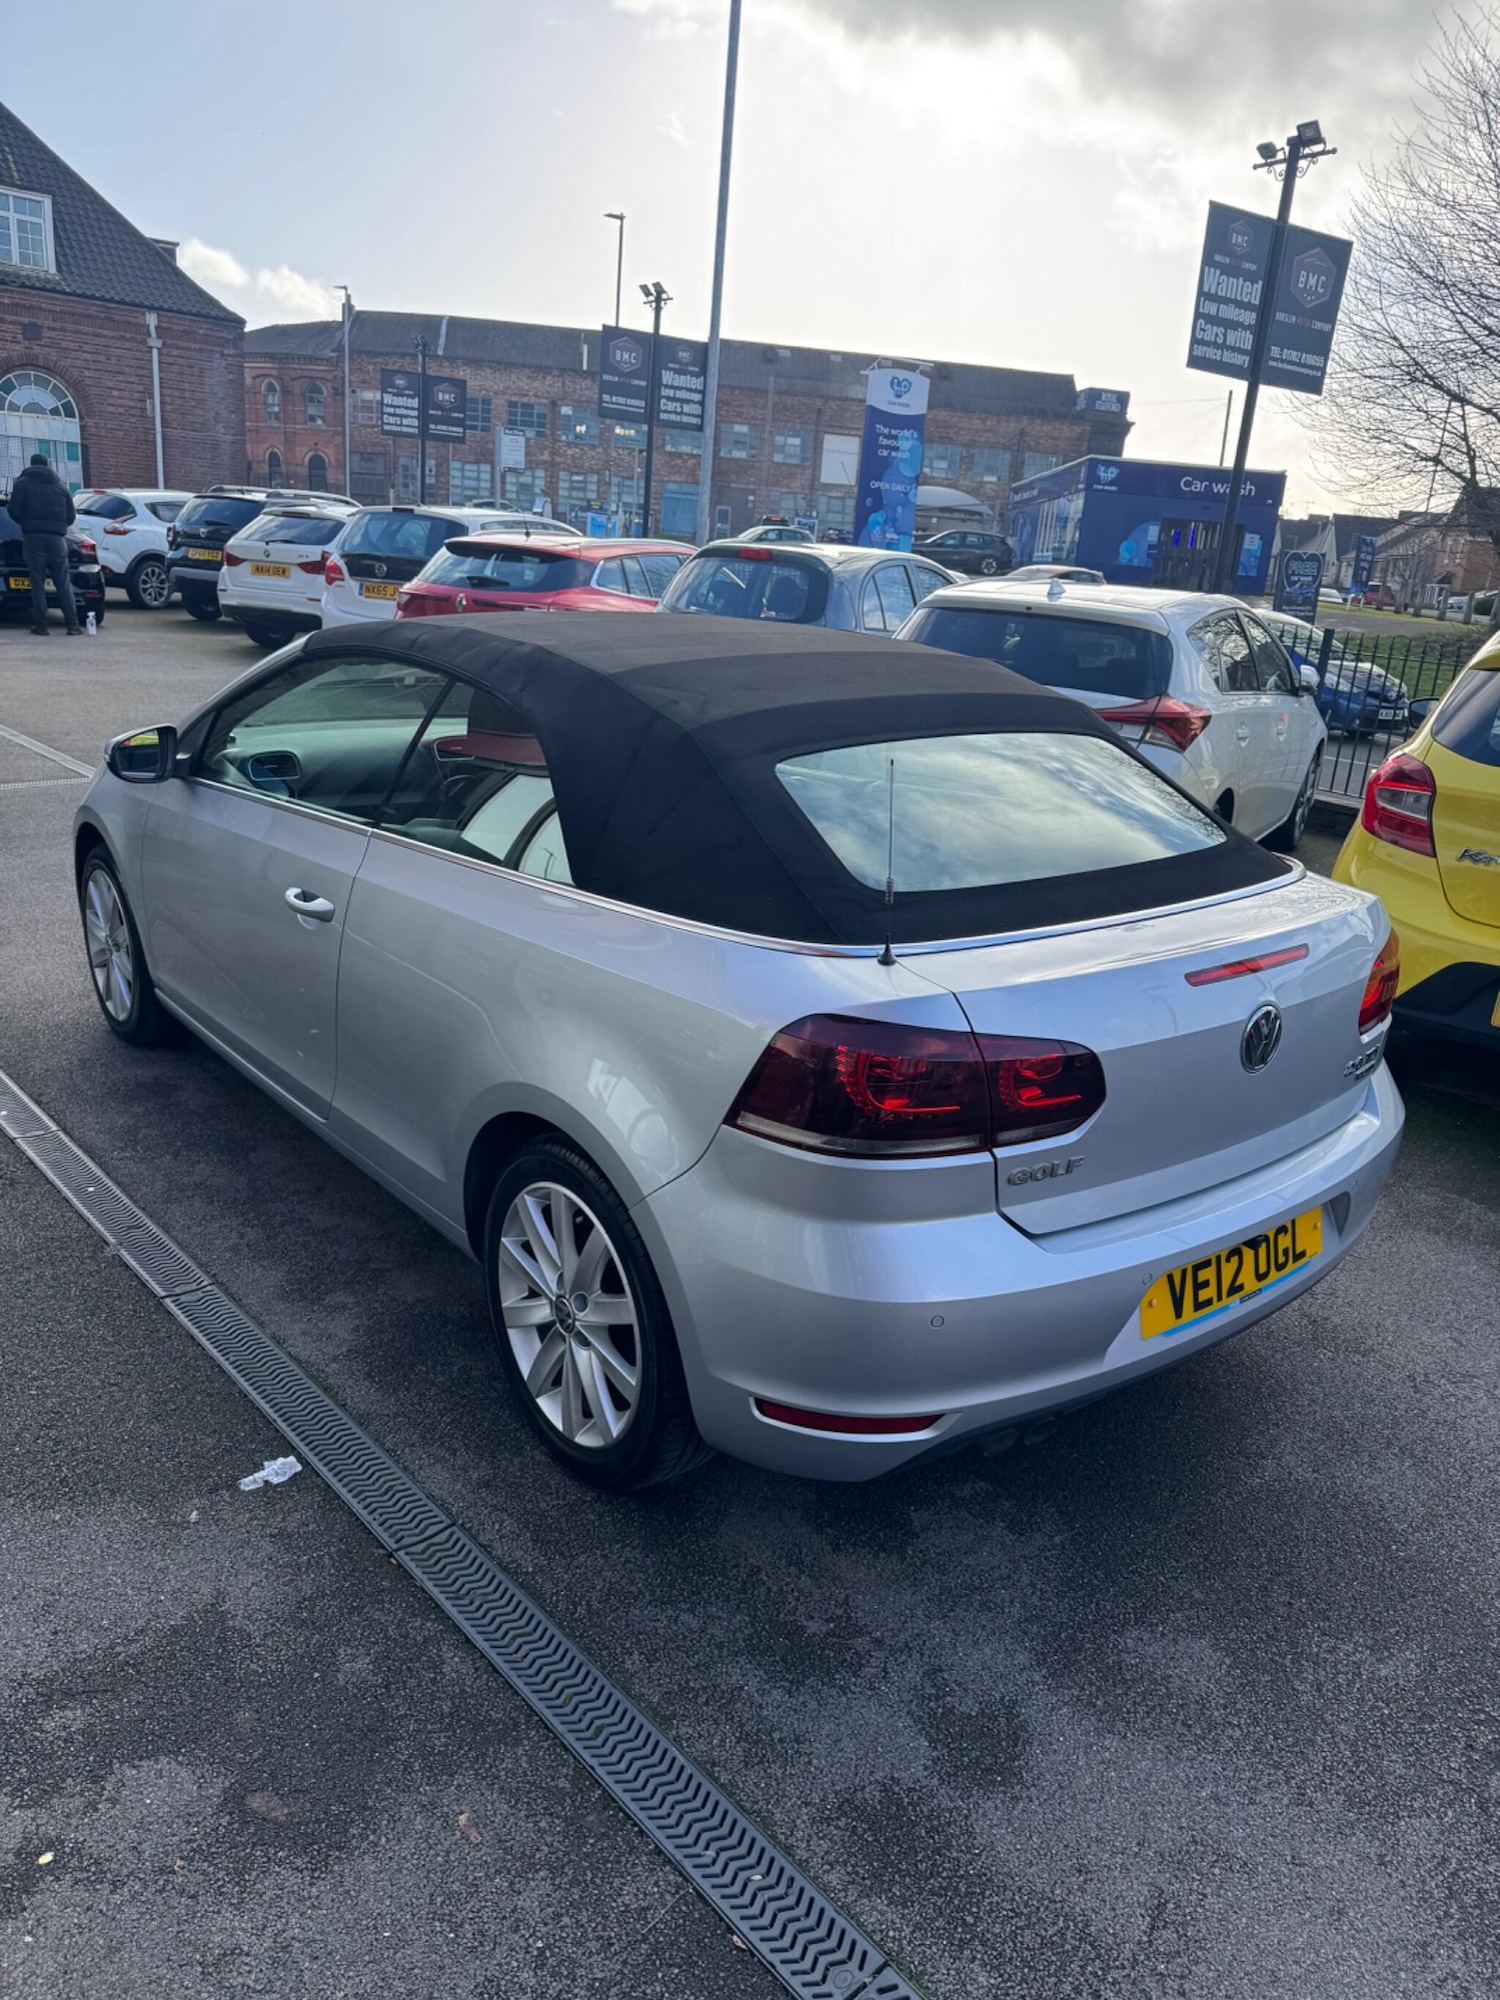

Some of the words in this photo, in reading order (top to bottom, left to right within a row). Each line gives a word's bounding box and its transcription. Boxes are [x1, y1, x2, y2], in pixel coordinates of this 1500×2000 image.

[1203, 266, 1263, 305] Wanted
[1298, 269, 1326, 293] BMC
[1199, 296, 1219, 316] Low
[1218, 303, 1257, 325] mileage
[1195, 318, 1225, 344] Cars
[1226, 328, 1254, 350] with
[616, 349, 637, 364] BMC
[1192, 344, 1222, 361] service
[1222, 348, 1250, 368] history
[661, 369, 705, 390] Wanted
[383, 393, 419, 409] Wanted
[660, 398, 682, 412] Cars
[875, 424, 890, 435] The
[870, 480, 890, 490] OPEN
[890, 482, 911, 493] DAILY
[1180, 476, 1210, 492] Car
[363, 584, 388, 597] NX65
[1006, 1155, 1085, 1187] GOLF
[1166, 1246, 1245, 1320] VE12
[1252, 1218, 1307, 1284] OGL
